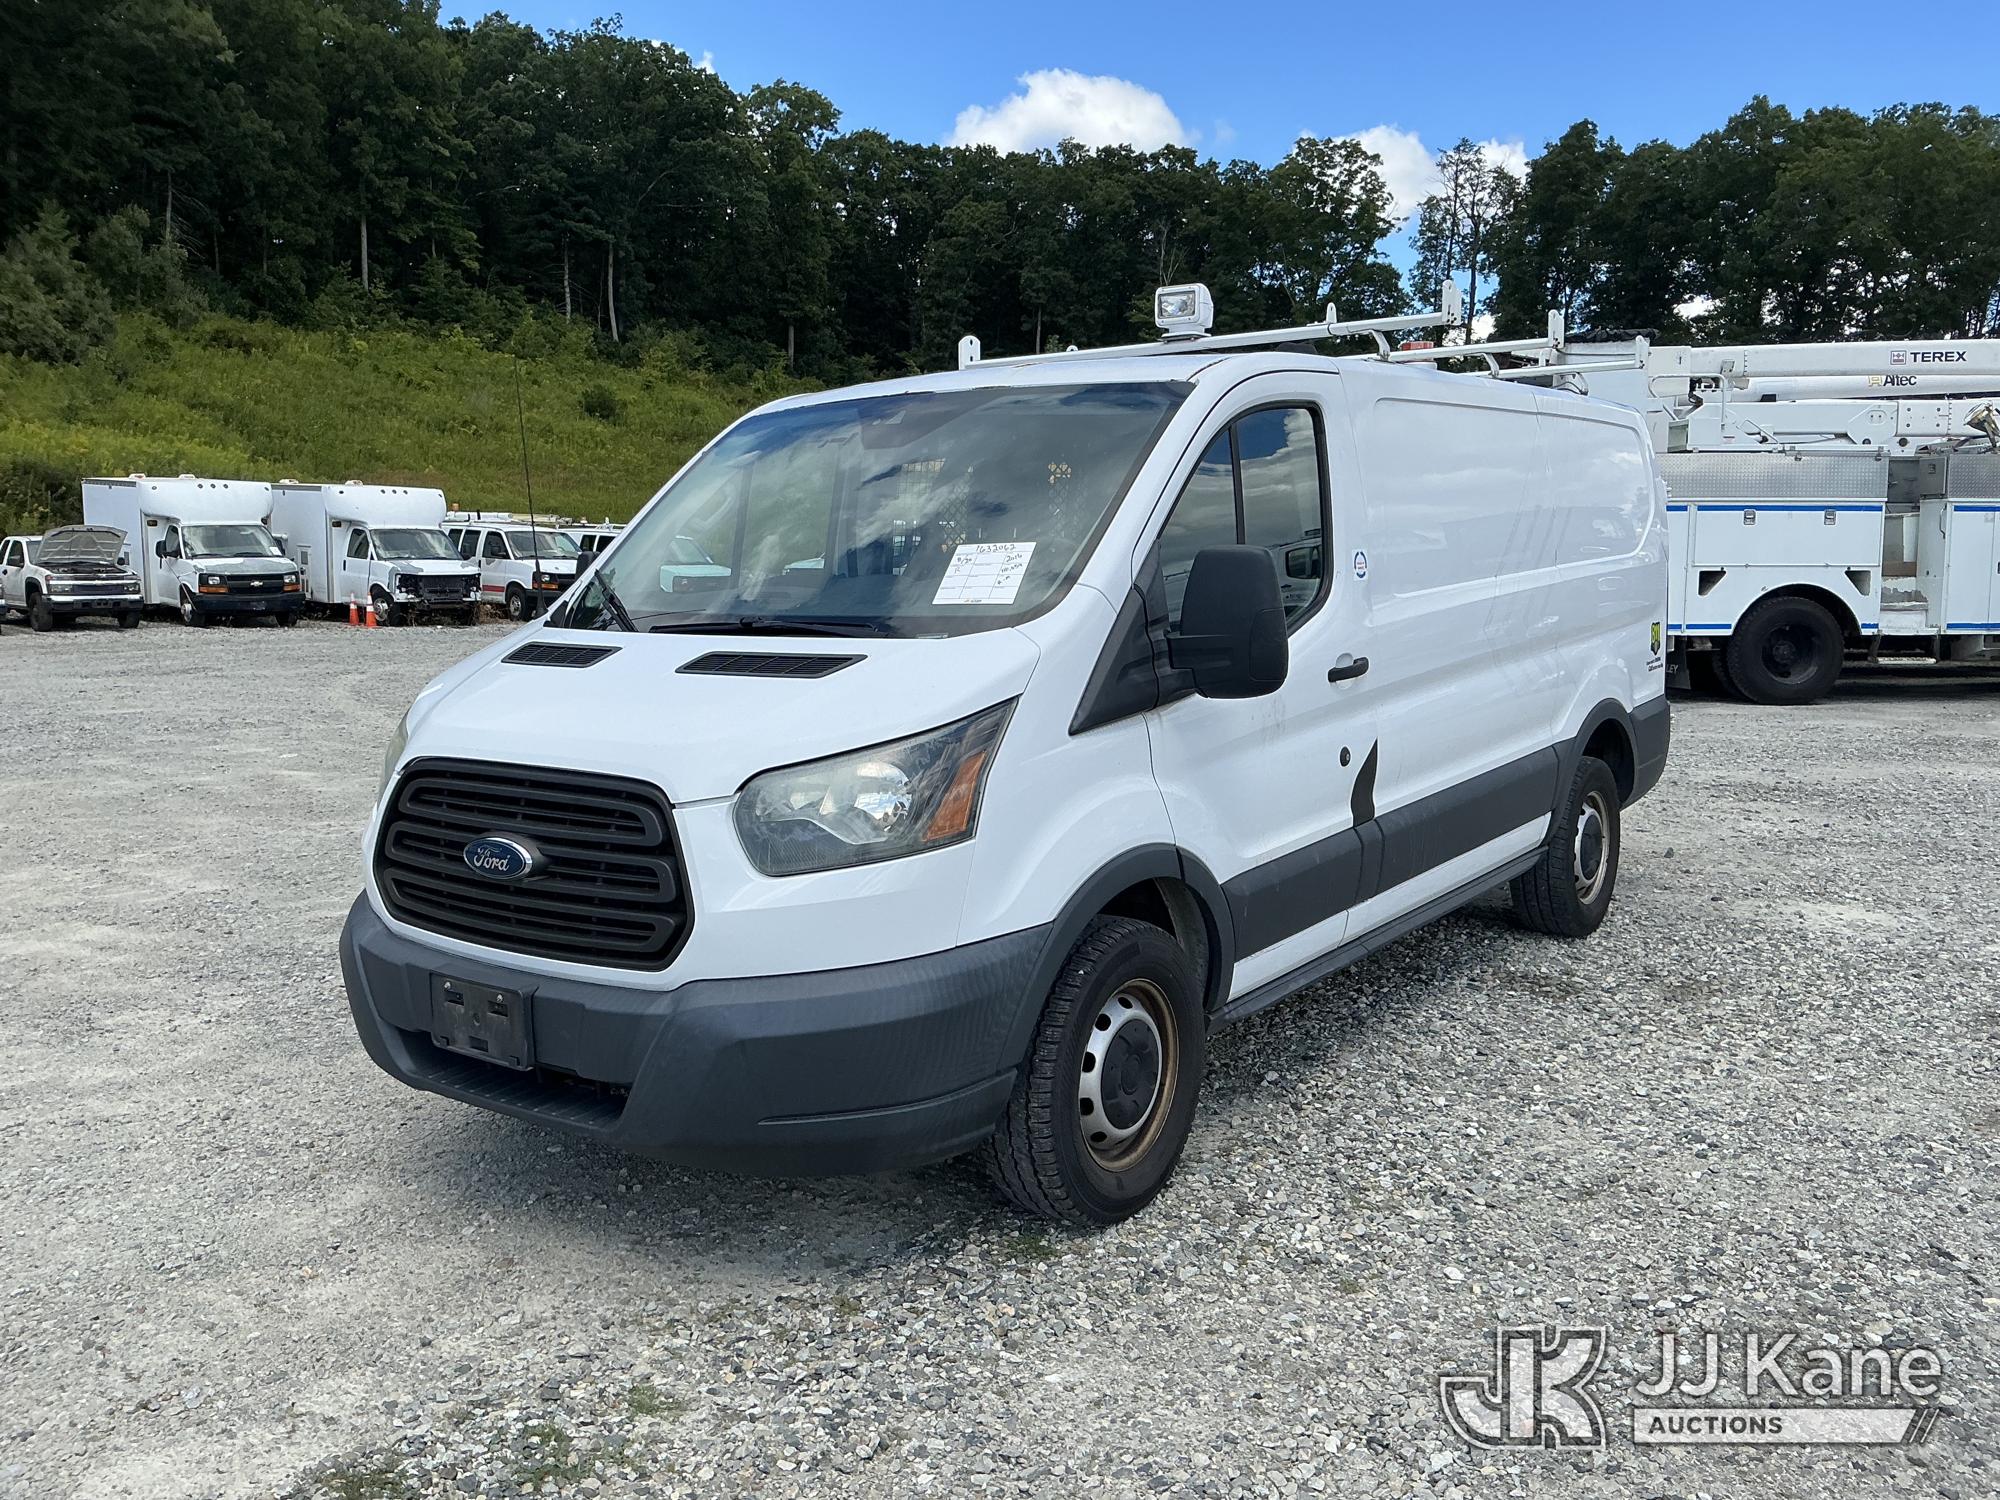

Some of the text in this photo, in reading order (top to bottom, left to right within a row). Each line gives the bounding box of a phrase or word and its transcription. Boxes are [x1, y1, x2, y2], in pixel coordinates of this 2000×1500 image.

[1910, 350, 1967, 363] TEREX
[1883, 374, 1917, 387] Altec
[473, 844, 511, 872] Ford
